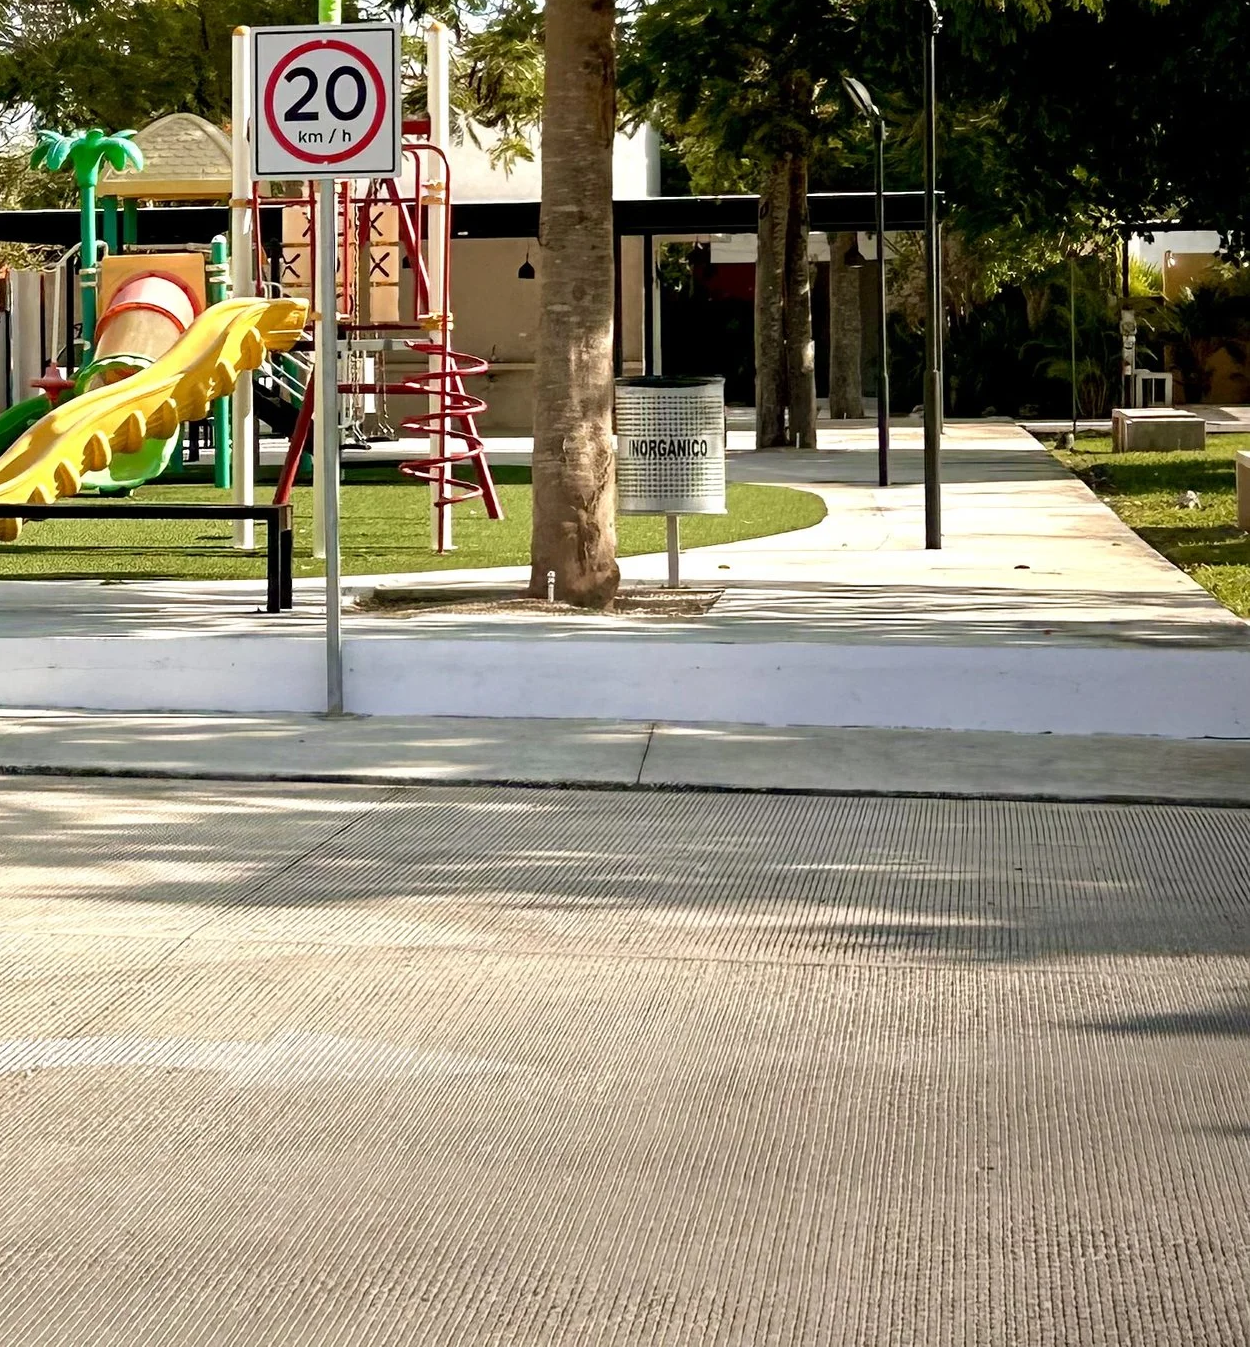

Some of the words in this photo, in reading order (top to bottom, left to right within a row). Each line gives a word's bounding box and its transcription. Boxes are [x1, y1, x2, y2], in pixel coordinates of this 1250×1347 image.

[283, 65, 367, 122] 20
[298, 130, 323, 144] km
[328, 128, 337, 144] /
[342, 129, 352, 143] h
